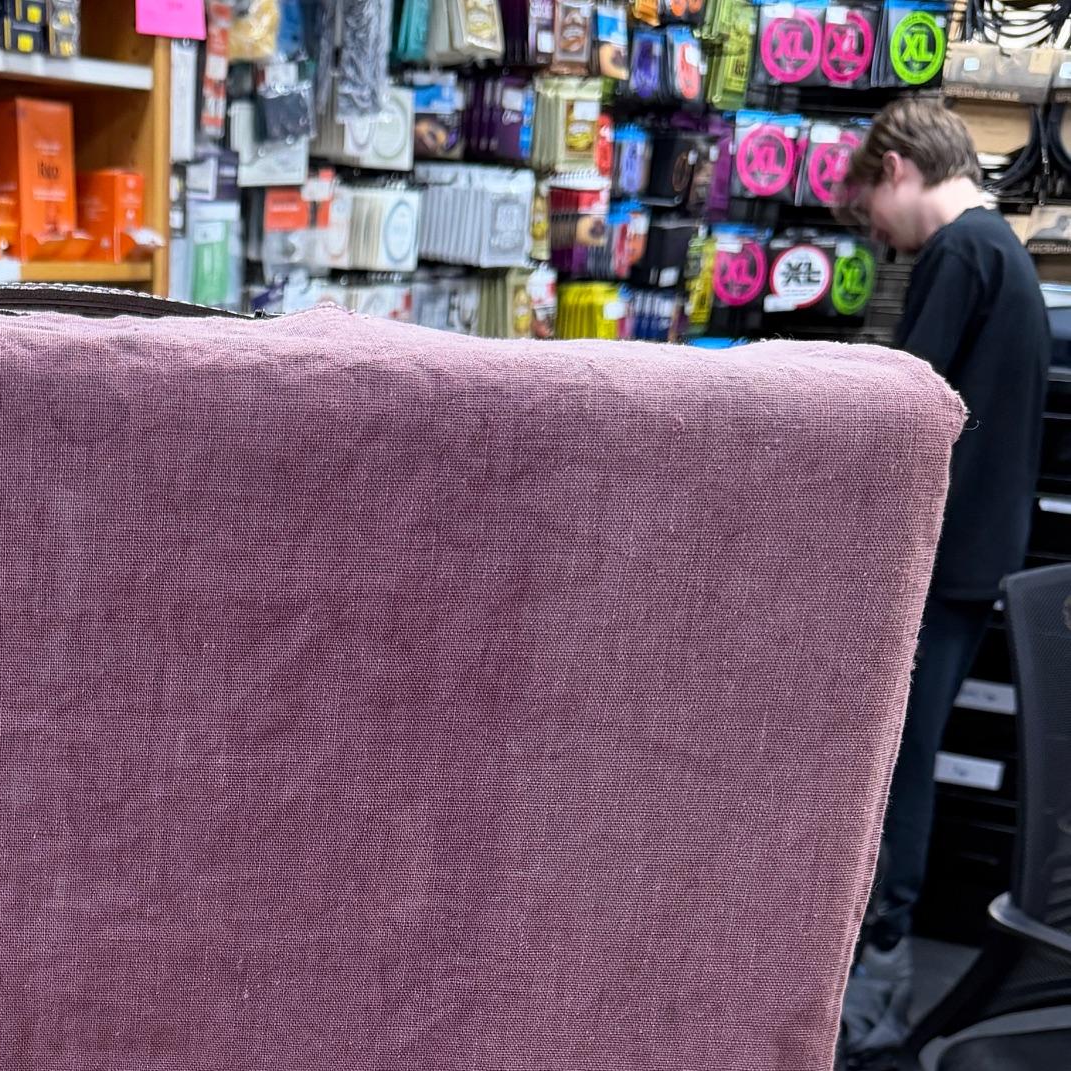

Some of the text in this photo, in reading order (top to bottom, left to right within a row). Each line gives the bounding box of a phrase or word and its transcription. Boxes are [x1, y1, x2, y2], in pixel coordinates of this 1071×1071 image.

[774, 30, 810, 60] XL
[901, 33, 933, 62] XL
[747, 146, 782, 174] XL
[720, 256, 757, 284] XL
[782, 261, 822, 287] XL
[842, 267, 867, 294] XL
